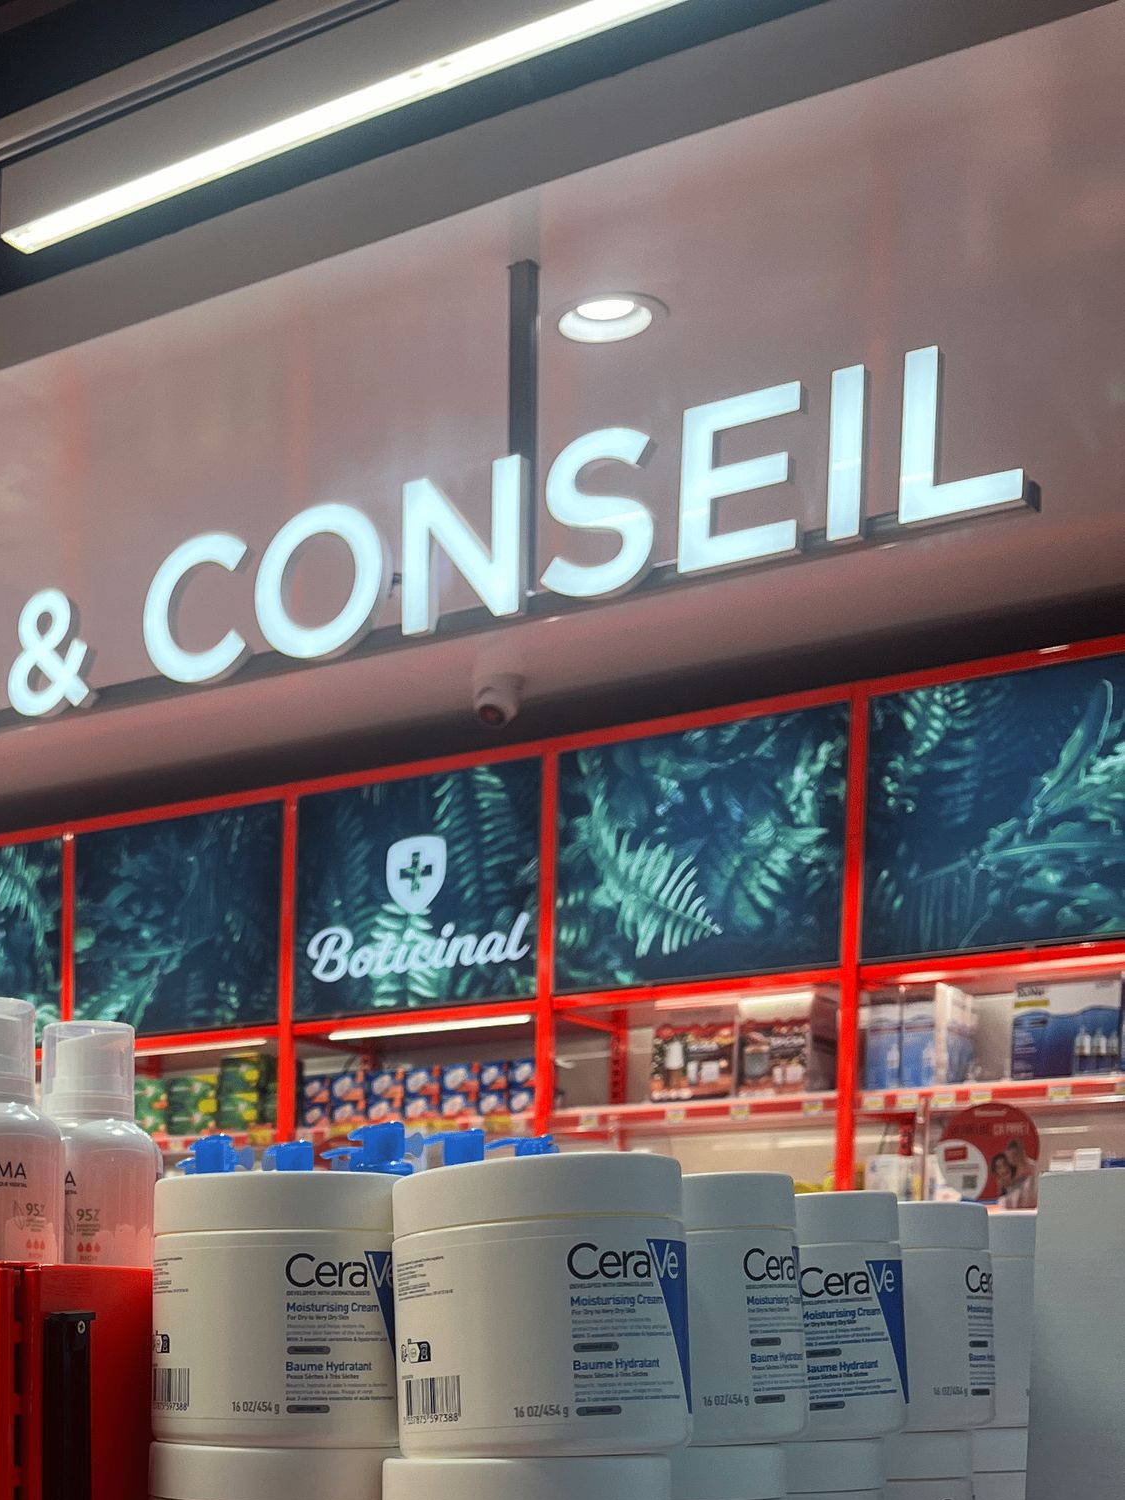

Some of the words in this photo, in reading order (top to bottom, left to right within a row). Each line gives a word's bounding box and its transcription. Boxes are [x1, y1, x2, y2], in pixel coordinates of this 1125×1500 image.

[8, 586, 92, 714] &
[142, 345, 1028, 684] CONSEIL
[306, 912, 530, 982] Boticinal
[567, 1242, 679, 1280] CeraVe
[800, 1263, 895, 1299] CeraVe
[570, 1294, 635, 1307] Moisturising
[637, 1294, 665, 1305] Cream
[286, 1302, 349, 1314] Moisturising
[351, 1303, 379, 1312] Cream
[573, 1360, 613, 1371] Baume
[615, 1358, 660, 1371] Hydratant
[750, 1353, 777, 1363] Baume
[286, 1361, 323, 1371] Baume
[326, 1361, 371, 1373] Hydratant
[839, 1359, 878, 1372] Hydratant
[232, 1401, 241, 1412] 16
[275, 1404, 280, 1415] g
[514, 1406, 525, 1418] 16
[563, 1406, 569, 1418] g
